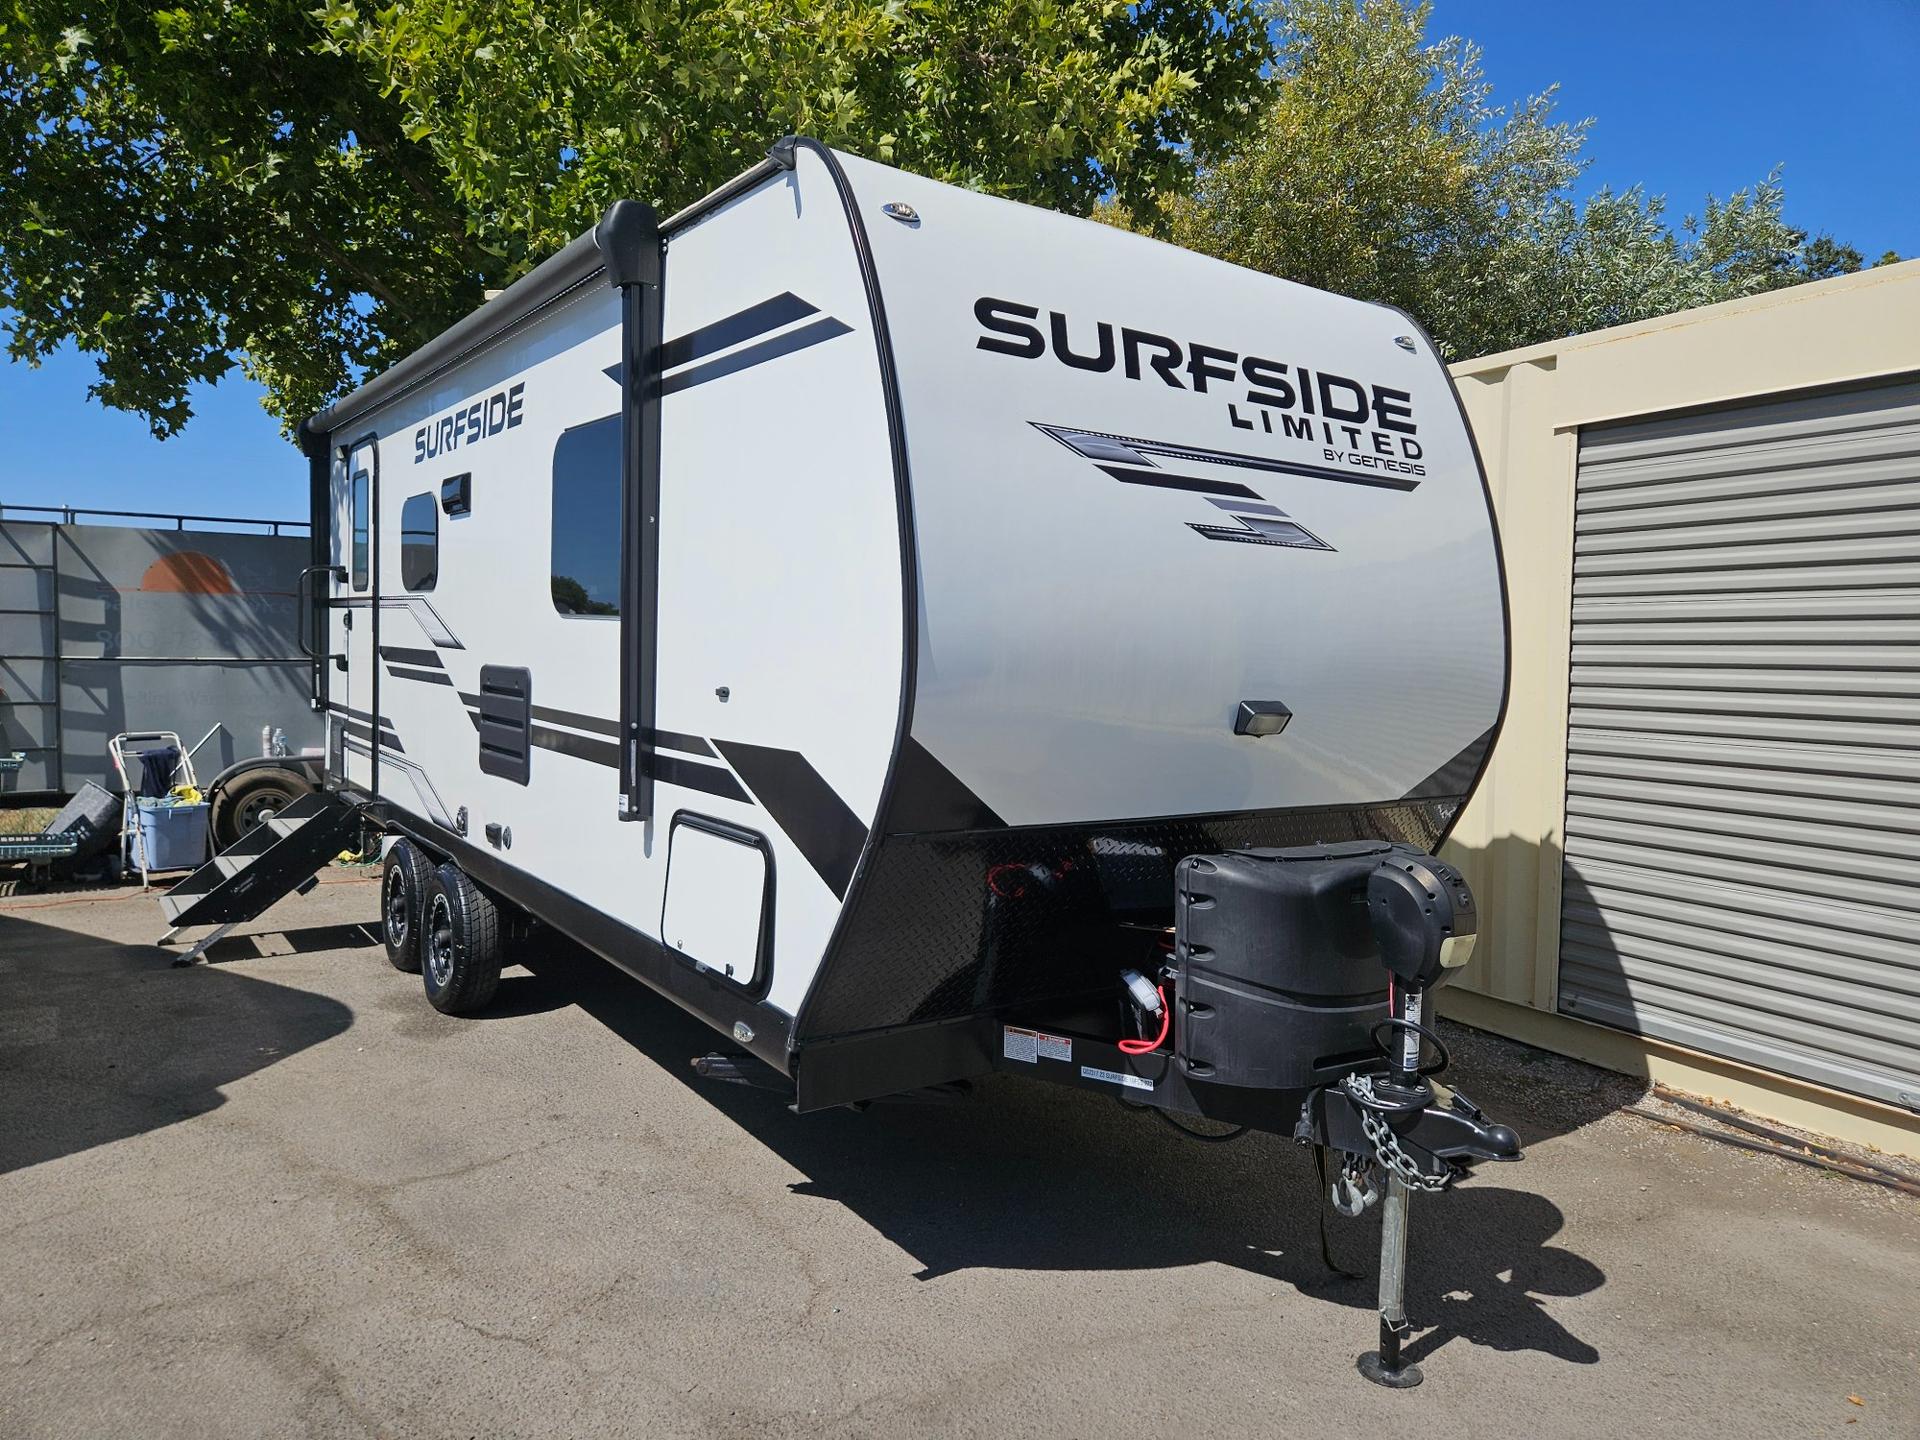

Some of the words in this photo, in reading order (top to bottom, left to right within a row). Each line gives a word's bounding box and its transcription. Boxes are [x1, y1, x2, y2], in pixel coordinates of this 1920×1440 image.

[974, 296, 1417, 435] SURFSIDE
[414, 381, 525, 464] SURFSIDE
[1228, 403, 1423, 460] LIMITED
[1323, 449, 1344, 462] BY
[1348, 453, 1426, 476] GENESIS
